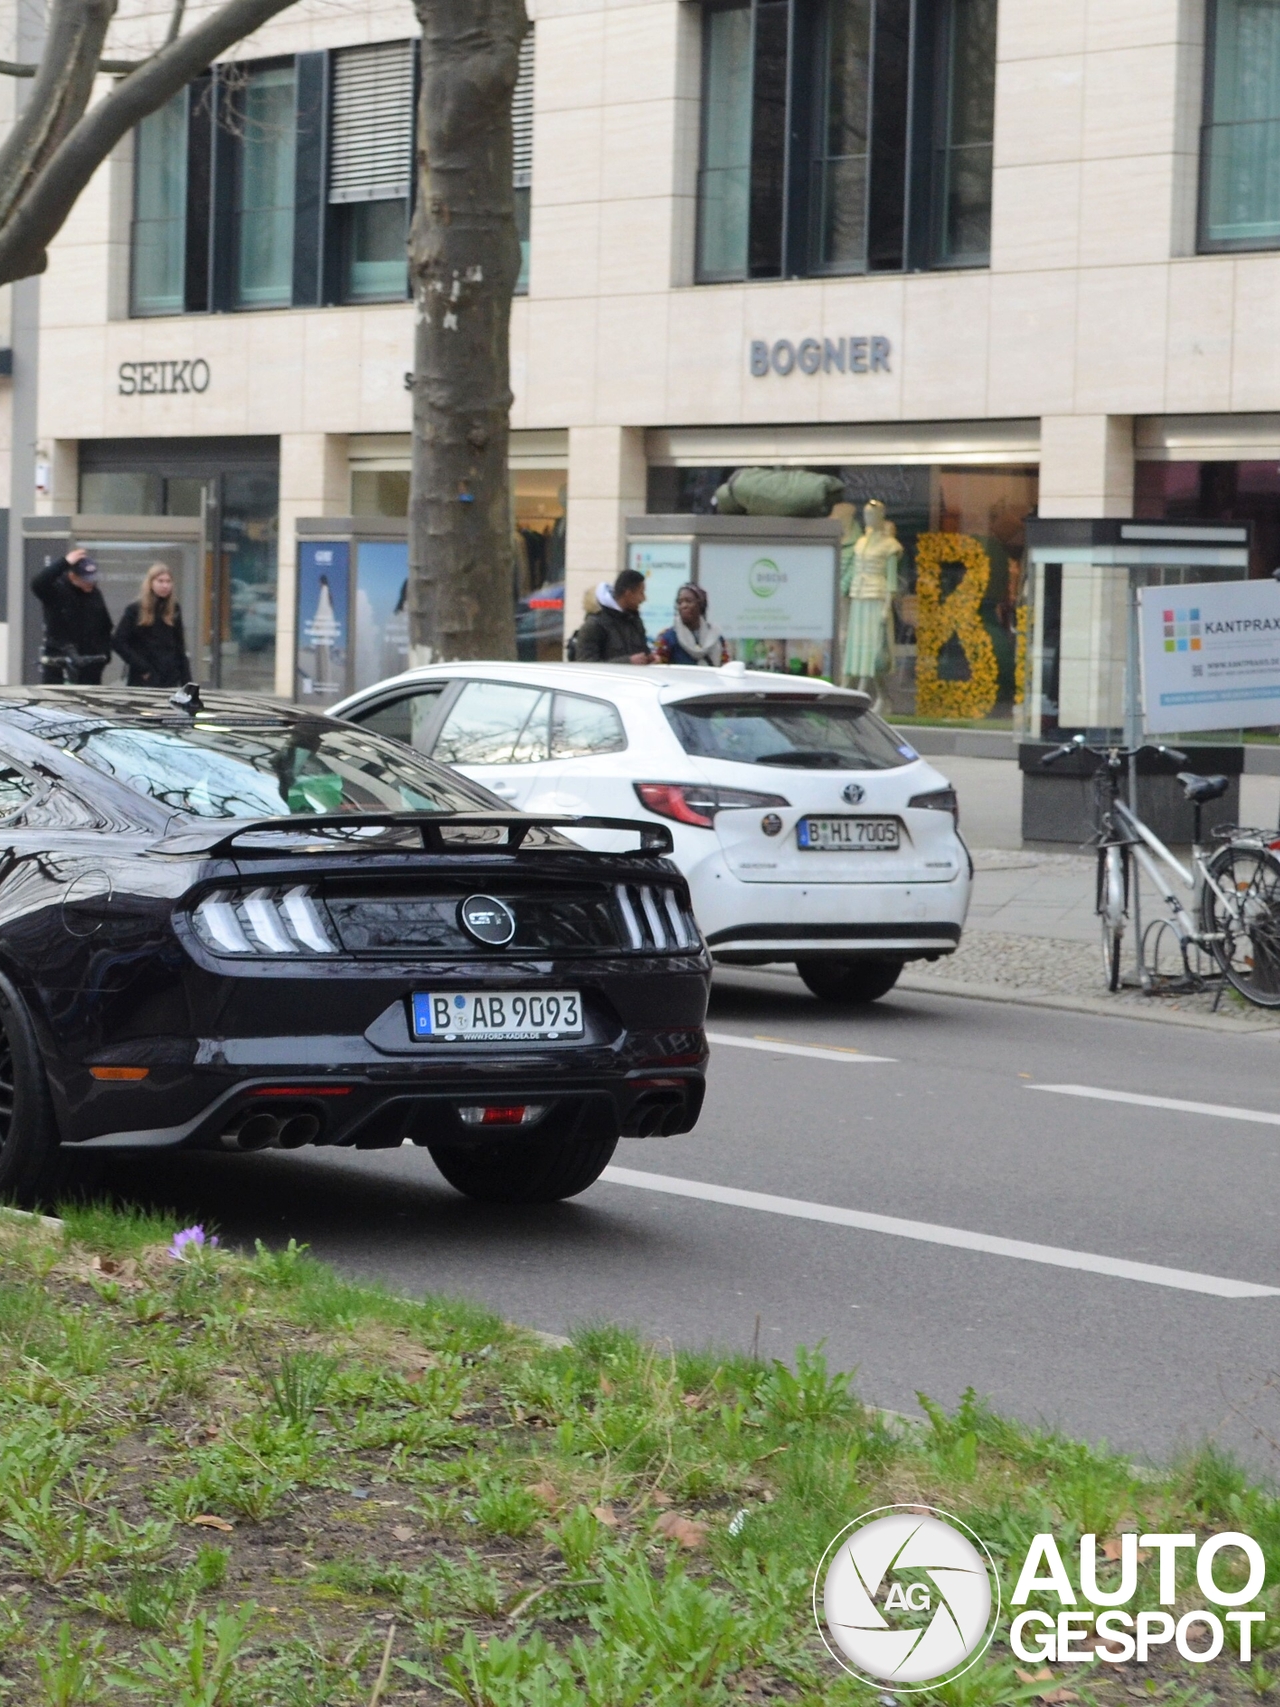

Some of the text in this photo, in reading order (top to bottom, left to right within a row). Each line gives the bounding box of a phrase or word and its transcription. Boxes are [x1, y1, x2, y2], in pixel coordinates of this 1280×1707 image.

[750, 336, 891, 378] BOGNER
[119, 358, 210, 395] SEIKO
[809, 822, 819, 842] B
[831, 822, 850, 843] HI
[858, 822, 897, 843] 7005
[434, 998, 451, 1029] B
[472, 997, 506, 1029] AB
[513, 996, 578, 1028] 9093
